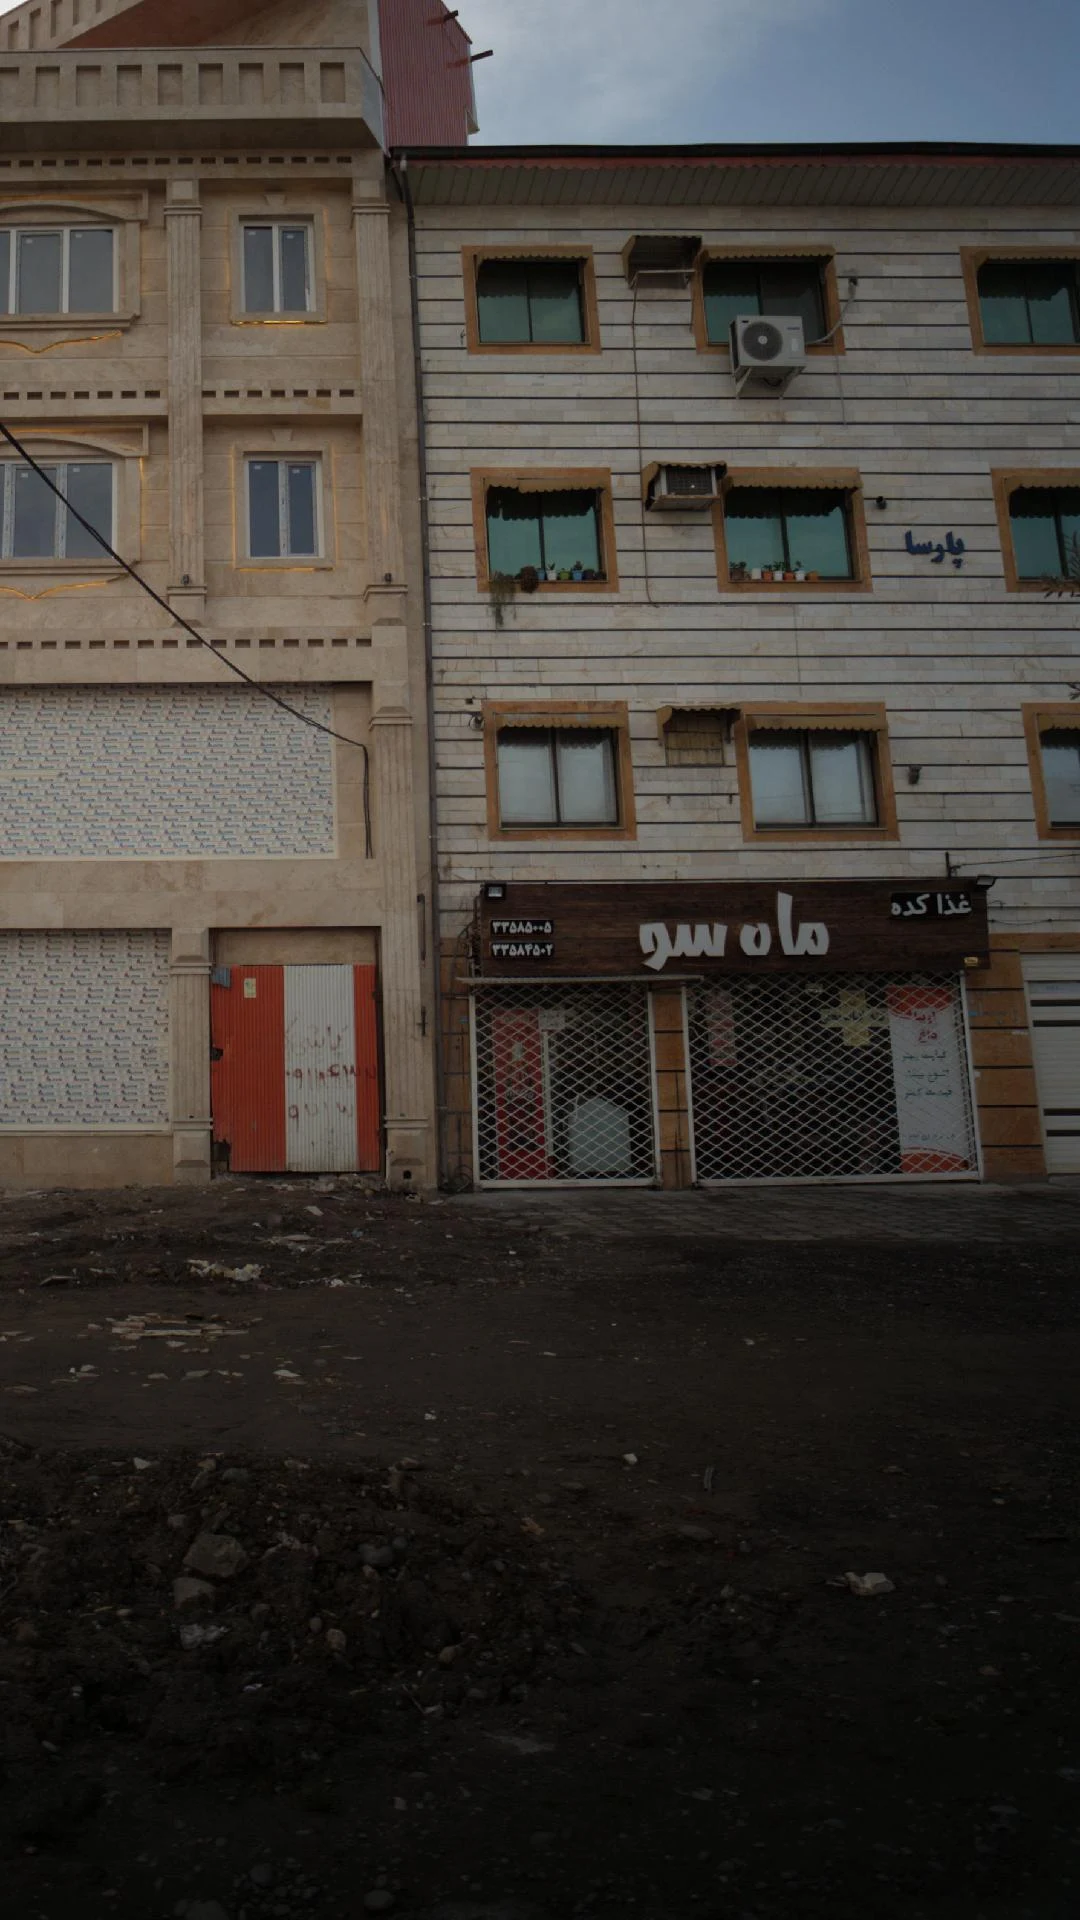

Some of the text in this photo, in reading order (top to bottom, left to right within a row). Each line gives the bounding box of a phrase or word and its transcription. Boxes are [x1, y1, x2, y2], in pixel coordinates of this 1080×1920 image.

[904, 530, 965, 569] پارسا
[890, 892, 973, 917] غذا کده
